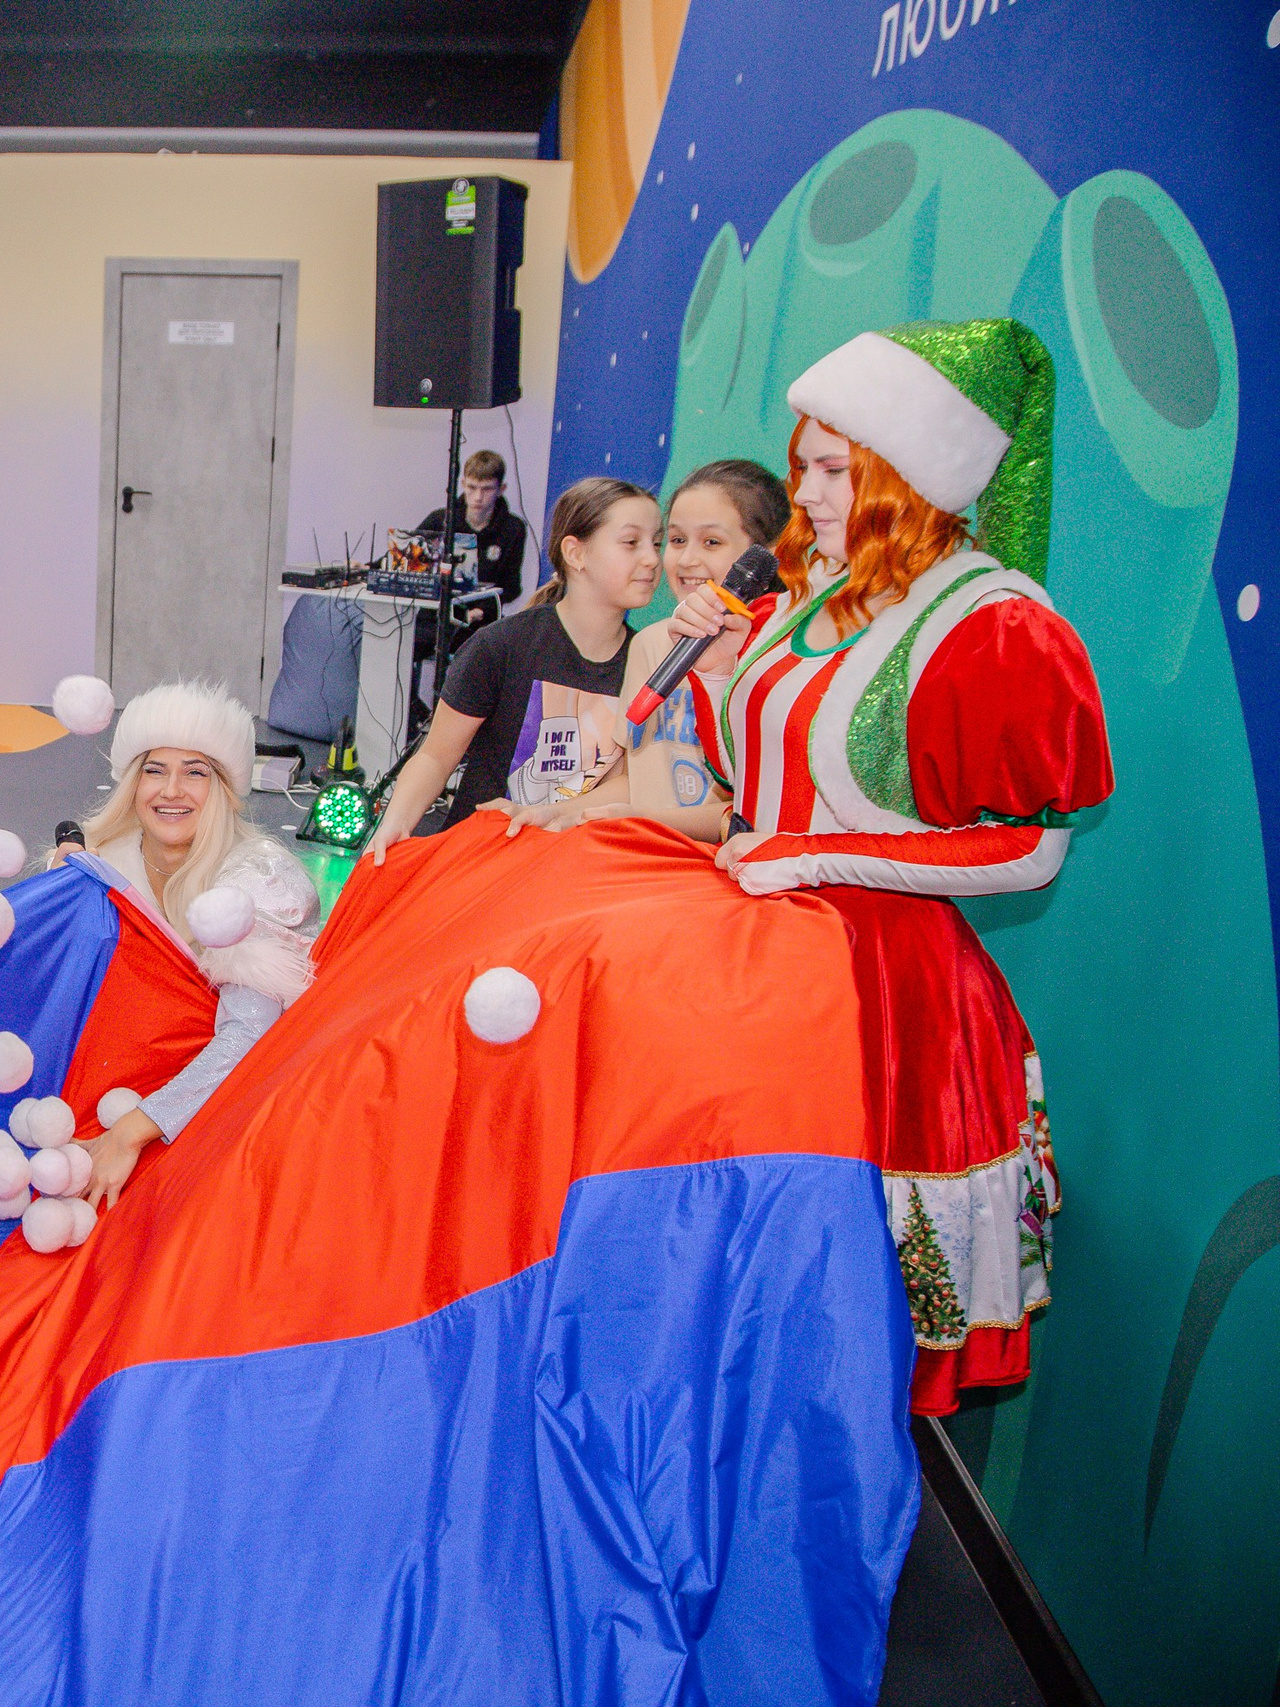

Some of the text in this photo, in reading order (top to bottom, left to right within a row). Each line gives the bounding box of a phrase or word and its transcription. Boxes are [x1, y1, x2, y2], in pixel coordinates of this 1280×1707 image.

[545, 730, 576, 744] I DO IT
[550, 744, 567, 757] FOR
[540, 759, 576, 773] MYSELF
